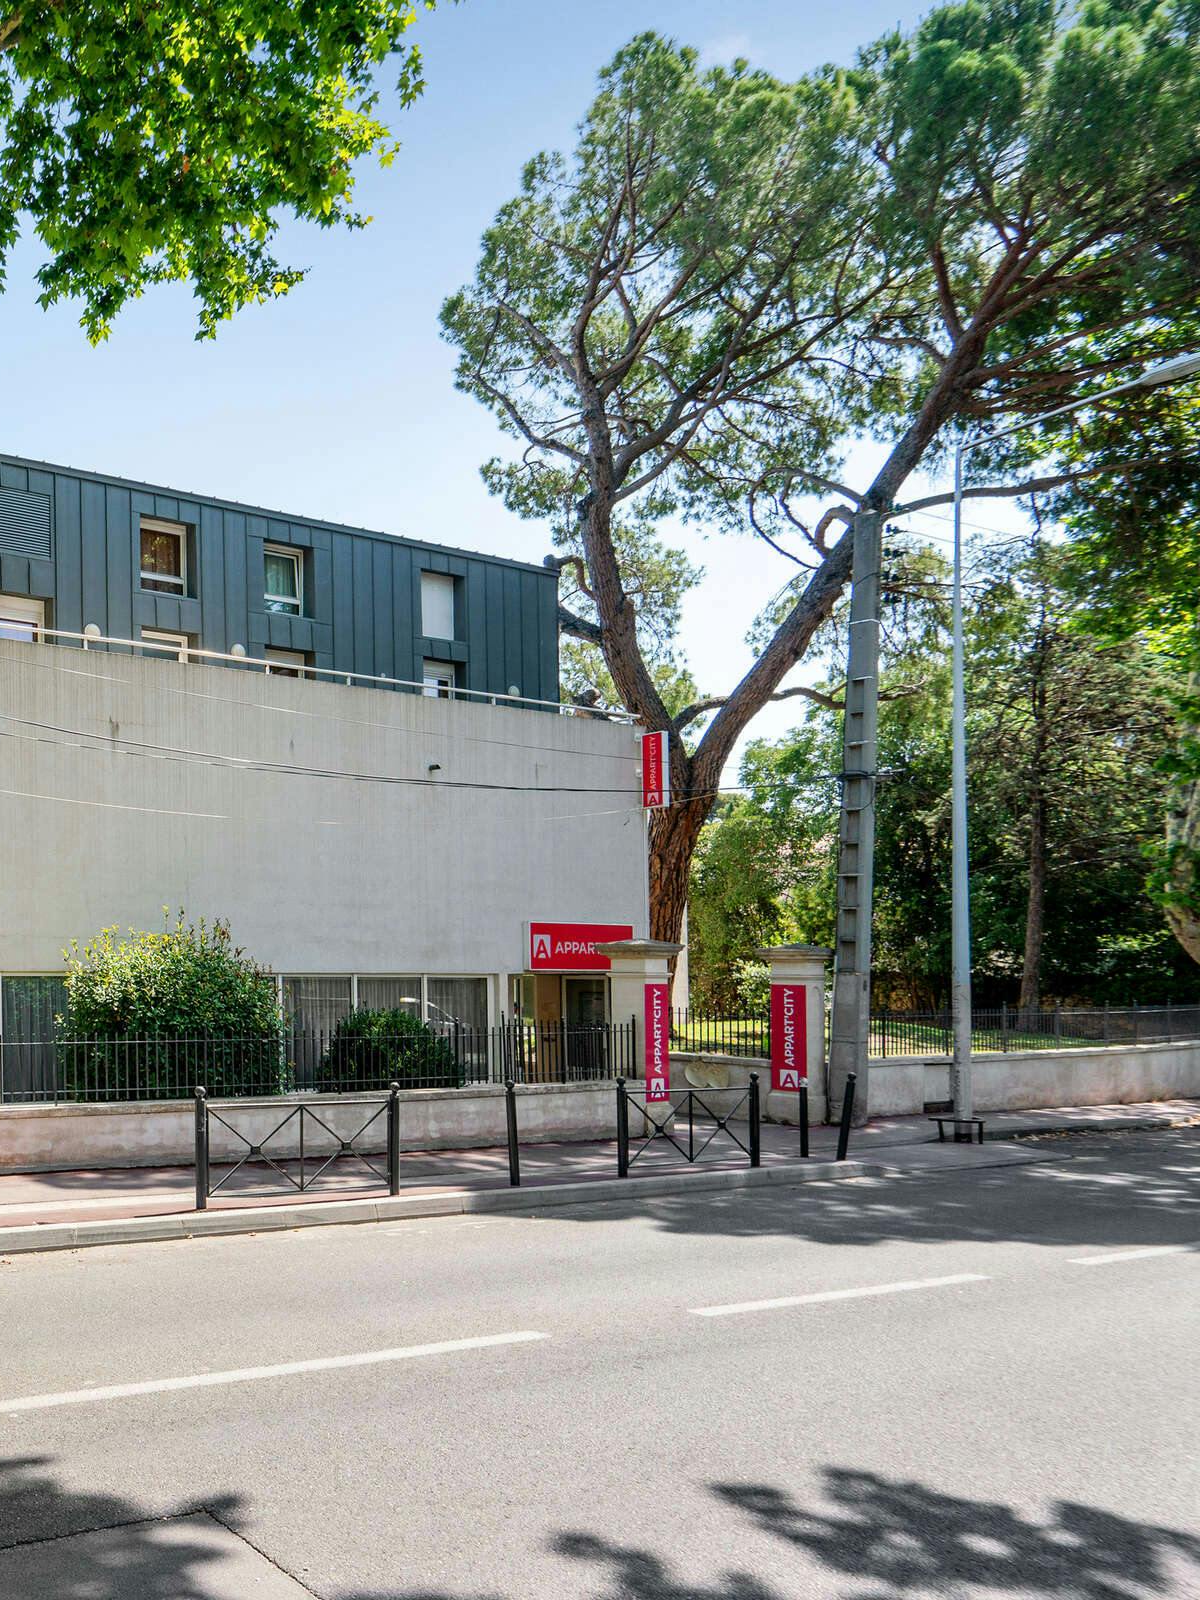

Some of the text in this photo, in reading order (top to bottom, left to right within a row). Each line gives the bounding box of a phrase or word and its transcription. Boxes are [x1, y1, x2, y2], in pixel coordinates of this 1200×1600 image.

[649, 736, 657, 790] APPART'CITY
[653, 988, 662, 1074] APPART'CITY
[783, 988, 794, 1067] APPART'CITY
